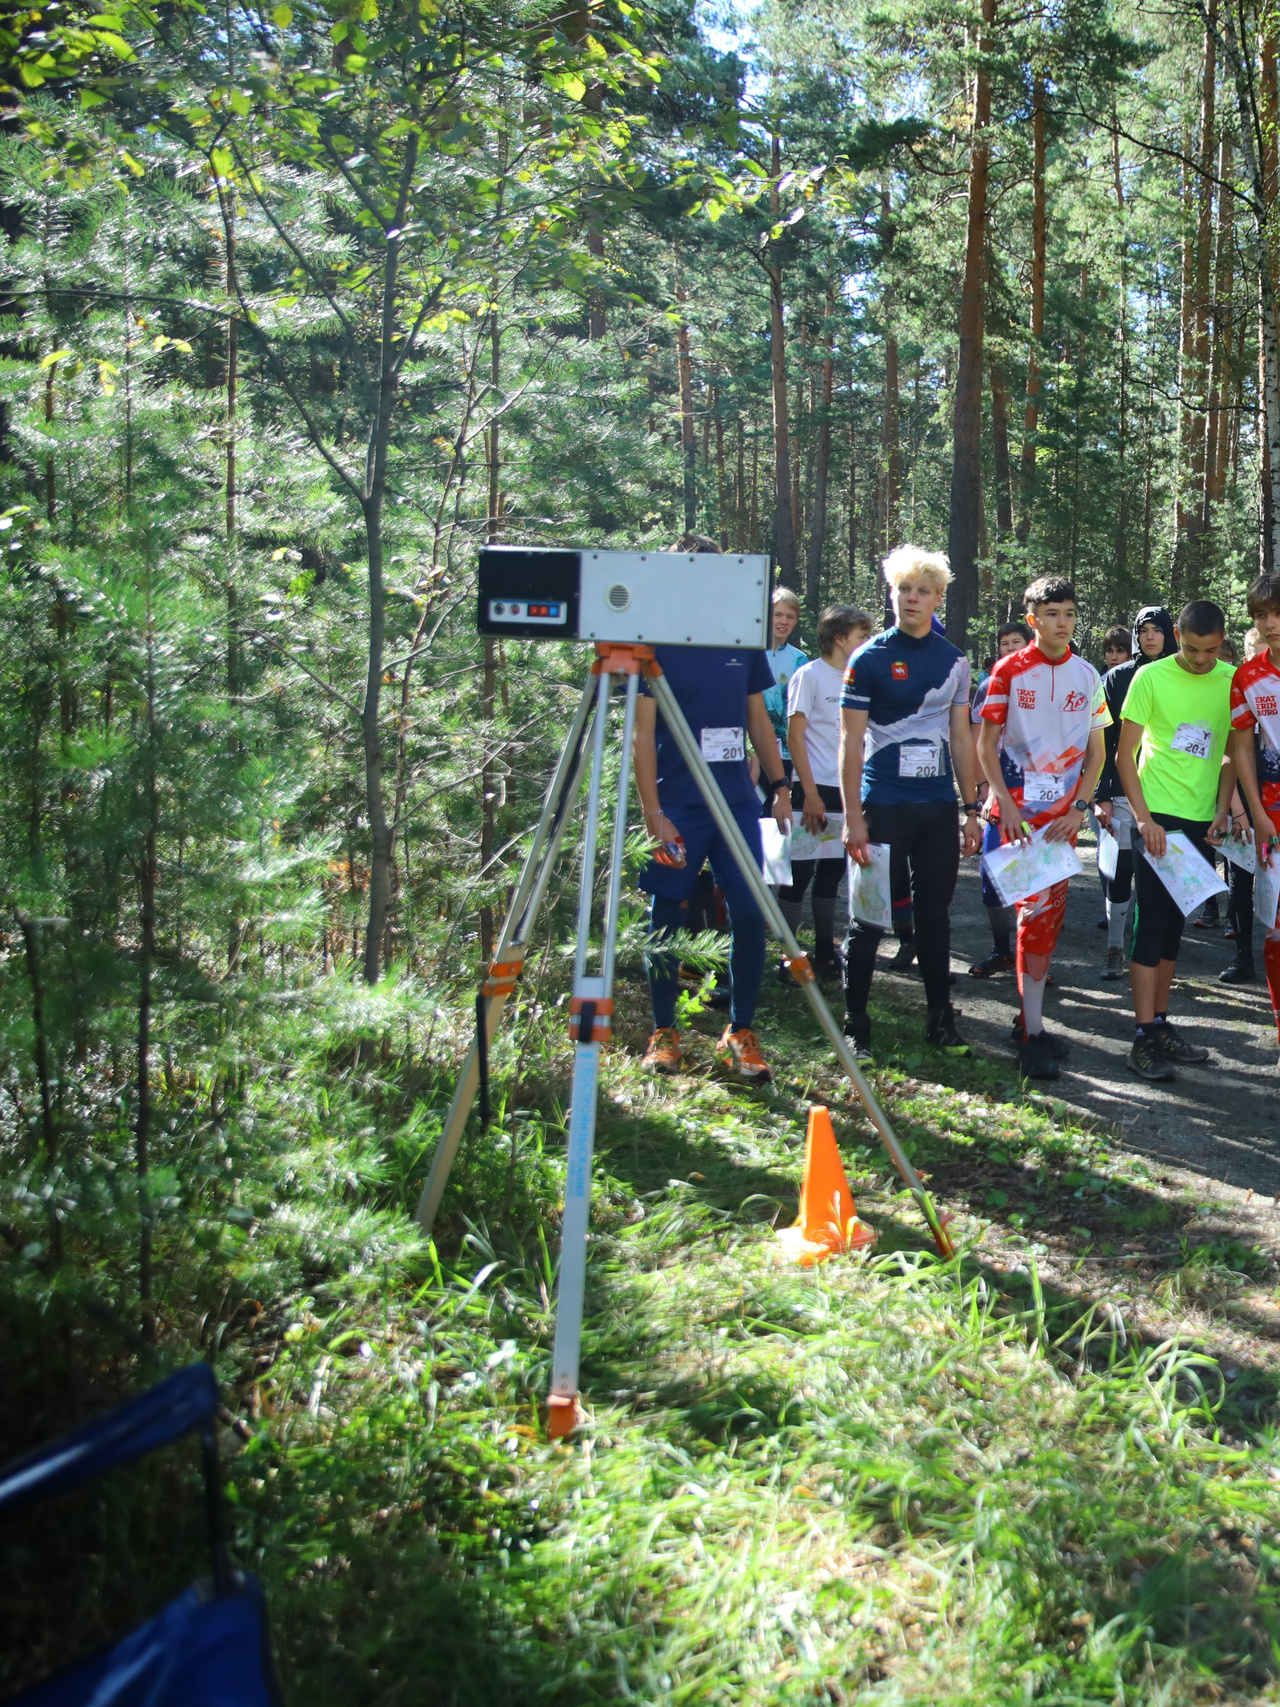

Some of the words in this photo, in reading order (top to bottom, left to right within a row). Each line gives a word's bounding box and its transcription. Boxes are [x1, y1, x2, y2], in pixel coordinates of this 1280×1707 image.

[1254, 695, 1276, 703] EKAT
[1256, 702, 1277, 710] ERIN
[1257, 708, 1279, 717] BURG
[722, 746, 743, 760] 201
[1185, 742, 1206, 757] 204
[915, 765, 937, 777] 202
[1040, 789, 1060, 801] 203
